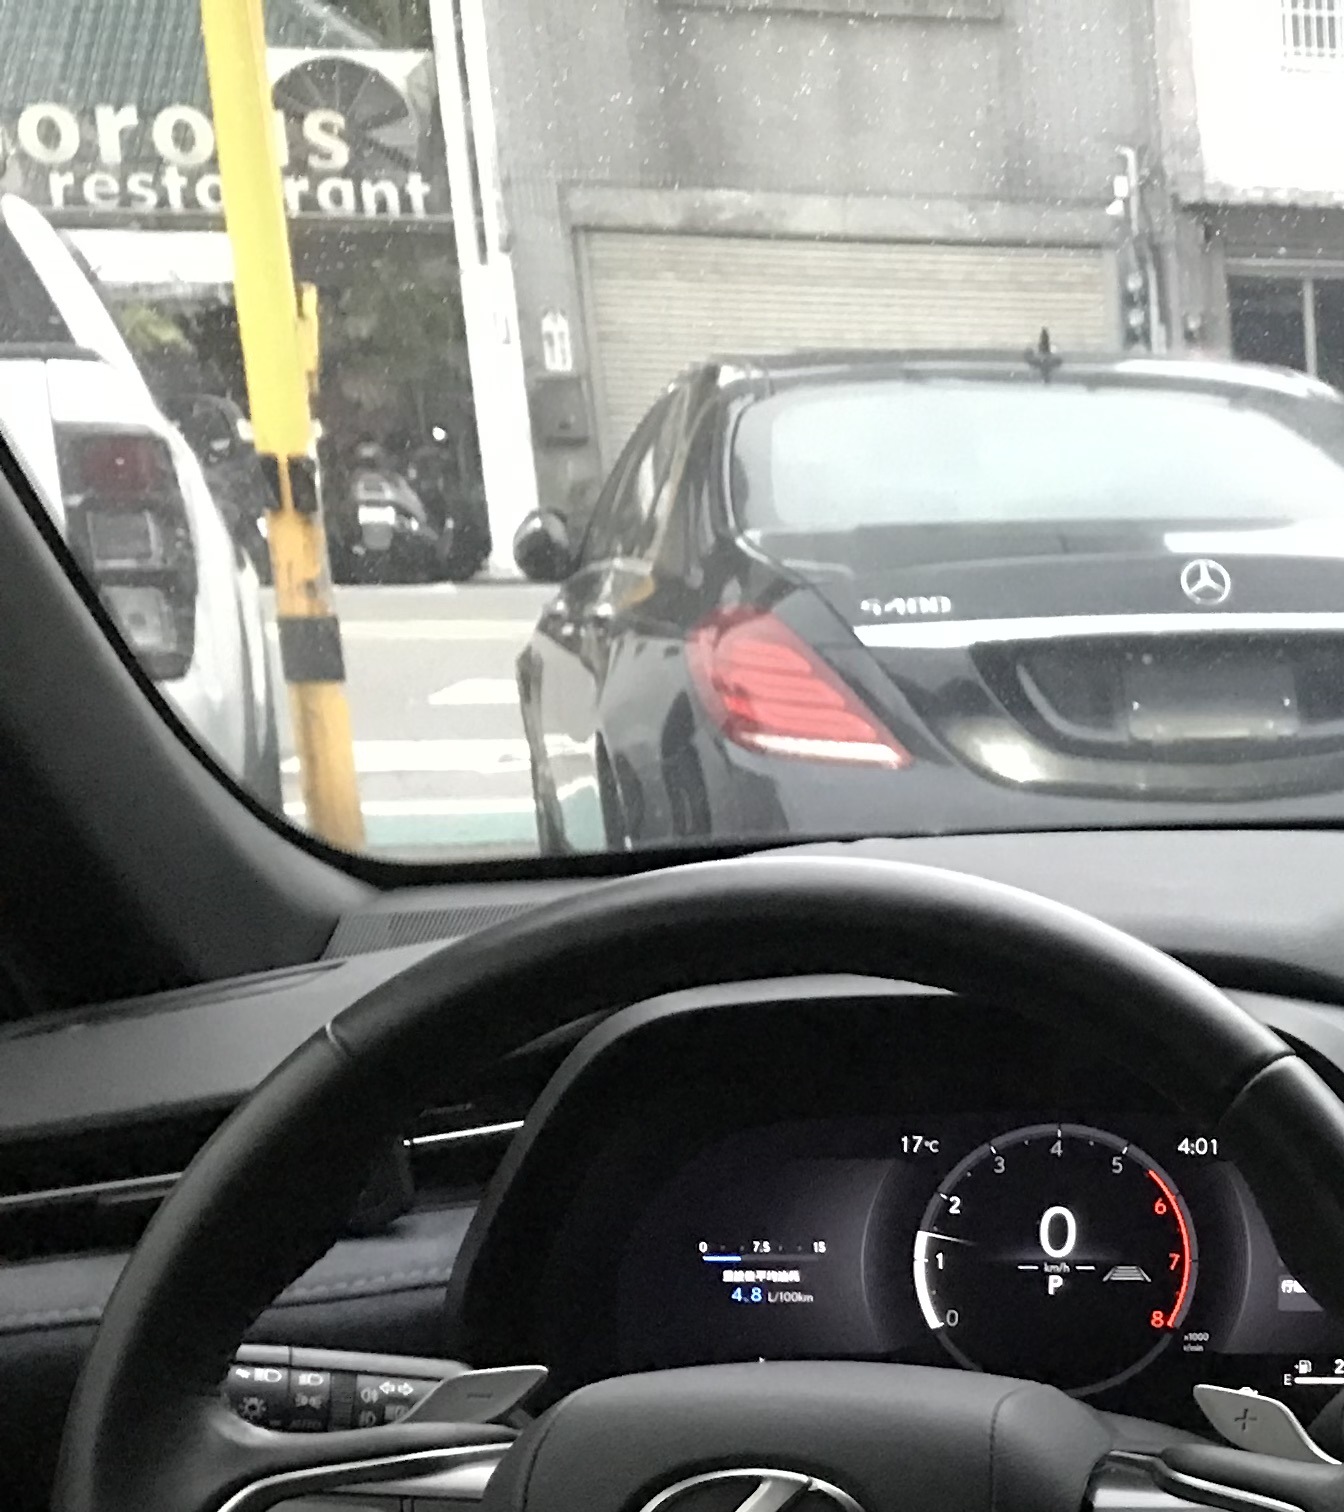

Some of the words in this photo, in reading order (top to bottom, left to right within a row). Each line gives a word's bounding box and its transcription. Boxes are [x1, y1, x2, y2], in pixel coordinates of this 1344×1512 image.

[0, 102, 351, 172] oros
[48, 165, 431, 218] restarant
[1049, 1139, 1064, 1157] 4
[1177, 1137, 1220, 1156] 4:01
[994, 1156, 1006, 1174] 3
[1111, 1157, 1124, 1175] 5
[948, 1196, 961, 1215] 2
[1154, 1198, 1167, 1216] 6
[1038, 1205, 1078, 1259] 0
[699, 1241, 708, 1253] 0
[752, 1240, 771, 1253] 7.5
[812, 1241, 827, 1253] 15
[935, 1253, 944, 1271] 1
[1043, 1262, 1071, 1274] km/h
[1168, 1253, 1181, 1271] 7
[731, 1286, 763, 1303] 4.8
[767, 1291, 814, 1303] L/100km
[1047, 1275, 1064, 1296] P
[946, 1310, 960, 1329] 0
[1150, 1310, 1164, 1329] 8
[1283, 1373, 1293, 1386] E
